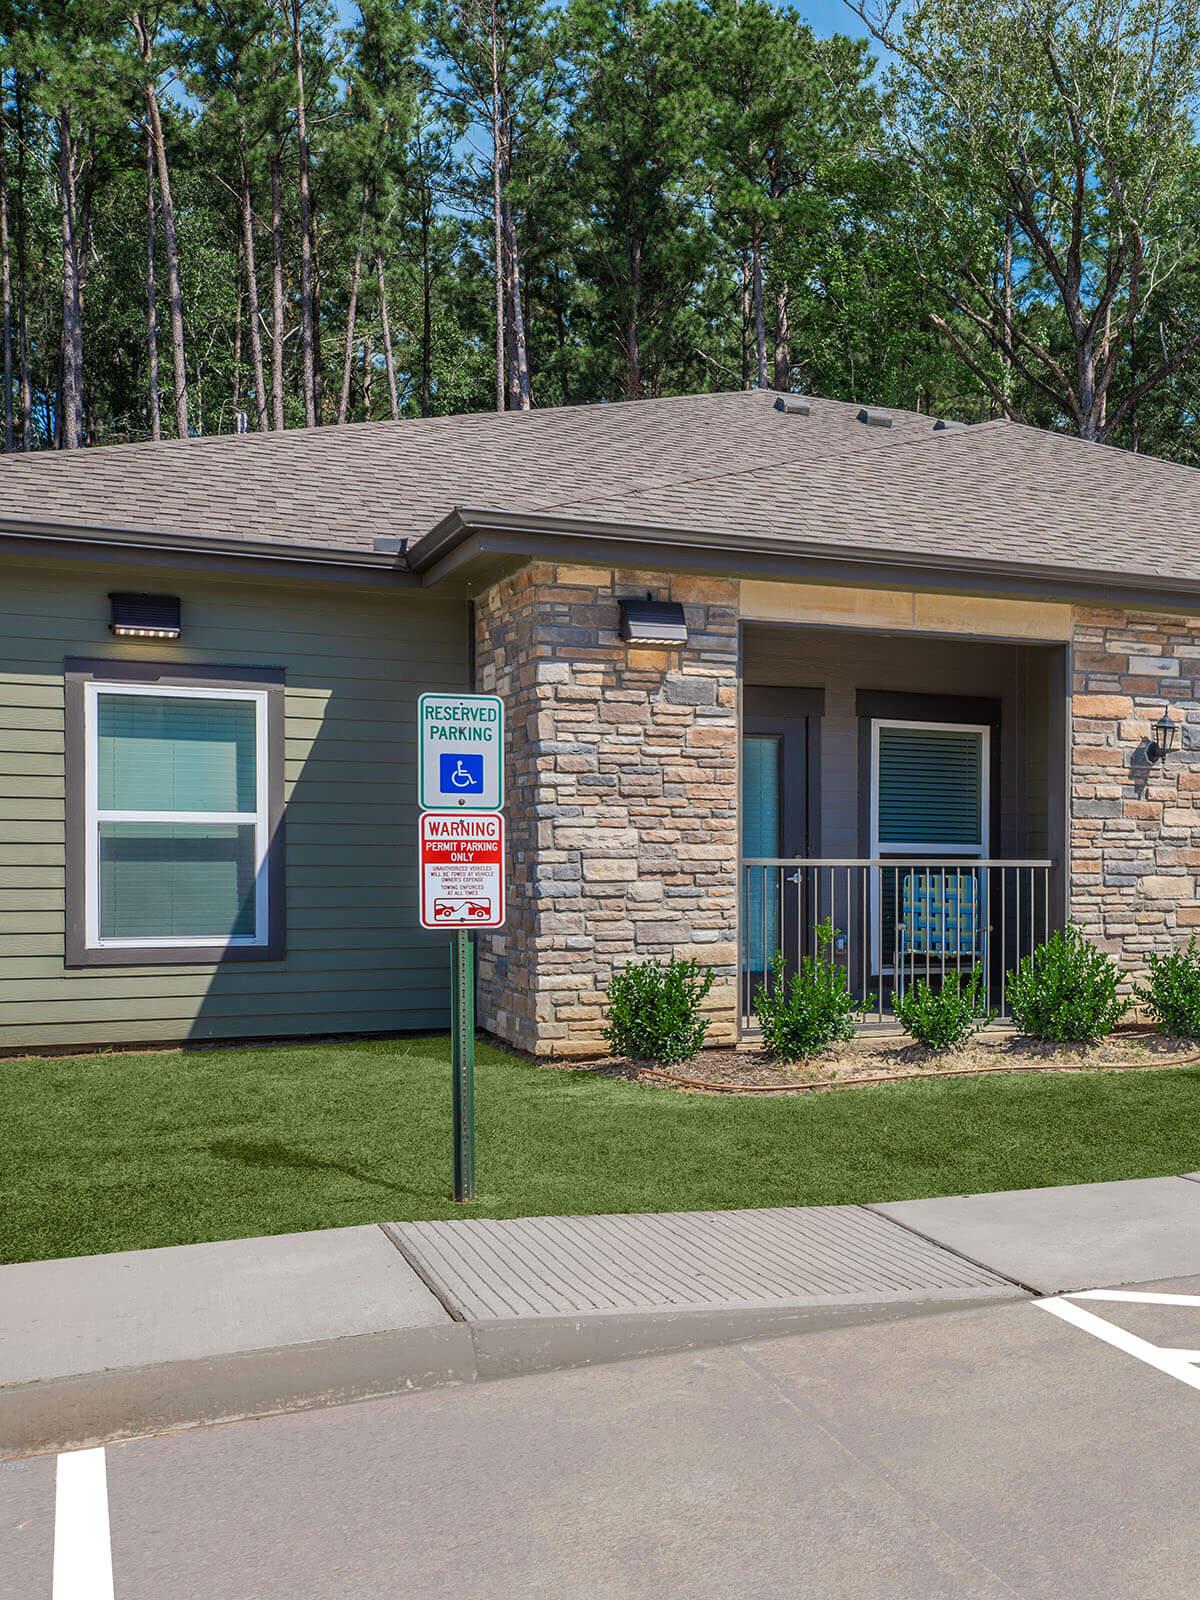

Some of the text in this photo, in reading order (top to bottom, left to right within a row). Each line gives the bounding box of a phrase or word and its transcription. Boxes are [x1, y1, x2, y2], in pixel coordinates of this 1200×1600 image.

[425, 706, 497, 722] RESERVED
[430, 726, 492, 742] PARKING
[428, 822, 496, 836] WARNING
[425, 842, 498, 852] PERMIT PARKING
[450, 852, 474, 862] ONLY
